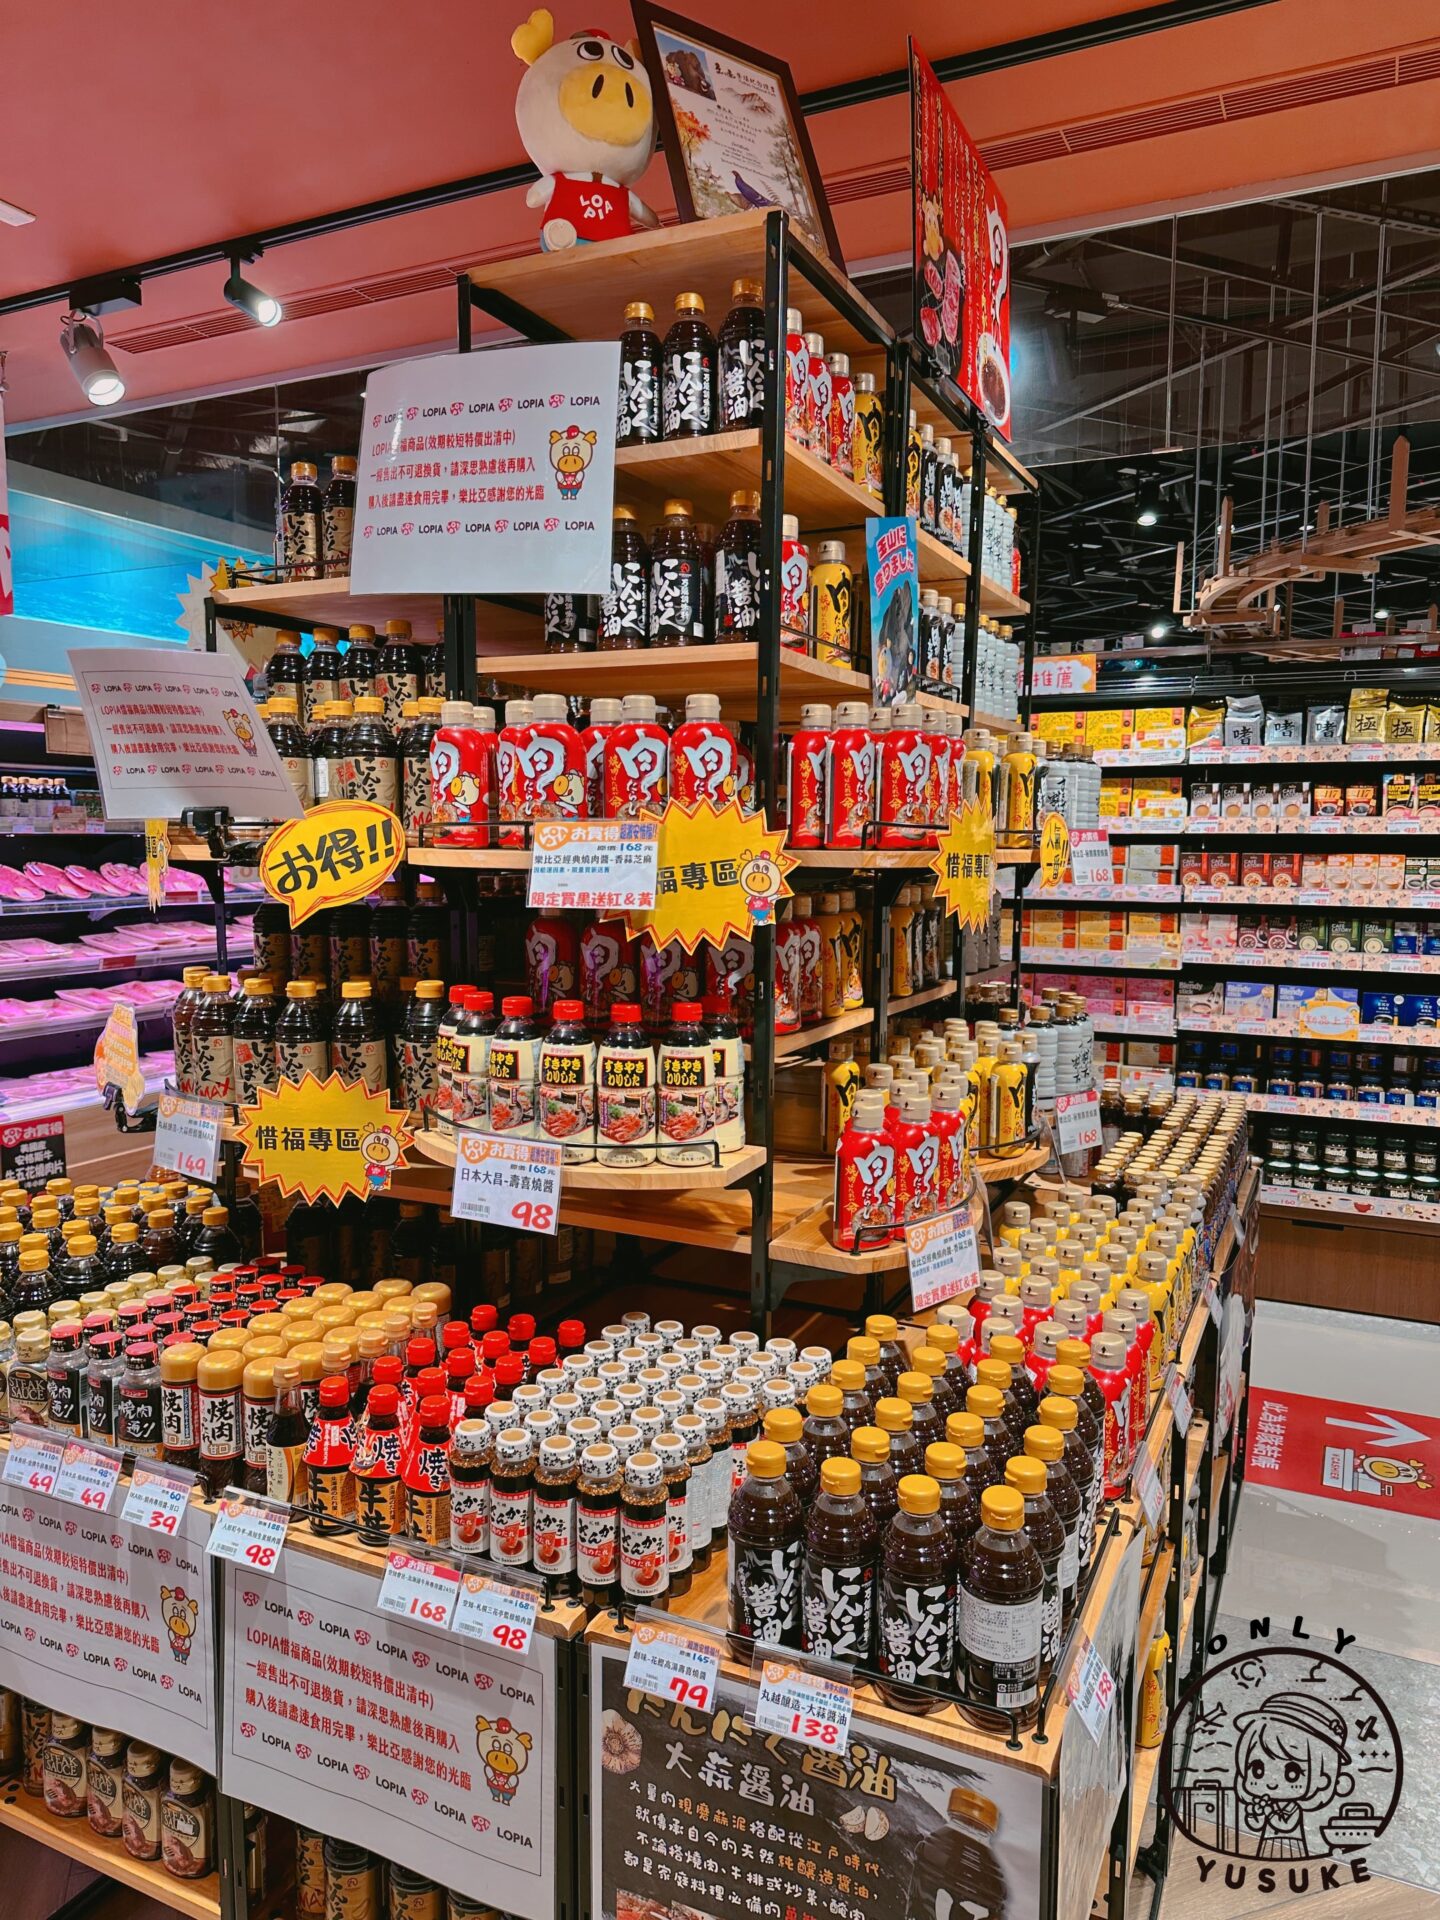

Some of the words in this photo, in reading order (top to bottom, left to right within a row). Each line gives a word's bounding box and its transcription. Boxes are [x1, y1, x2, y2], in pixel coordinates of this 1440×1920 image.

[422, 407, 447, 417] LOPIA
[469, 403, 495, 413] LOPIA
[517, 399, 544, 409] LOPIA
[570, 396, 600, 406] LOPIA
[376, 526, 398, 536] LOPIA
[418, 524, 443, 534] LOPIA
[465, 523, 491, 533] LOPIA
[513, 522, 540, 532] LOPIA
[565, 521, 595, 531] LOPIA
[268, 818, 395, 894] お得!!
[620, 843, 642, 851] 168
[1091, 869, 1108, 882] 168
[1179, 981, 1203, 991] Blendy
[544, 1055, 582, 1070] すきやき
[604, 1059, 646, 1074] すきやき
[664, 1057, 703, 1072] すきやき
[546, 1070, 577, 1084] わりした
[608, 1073, 641, 1087] わりした
[666, 1072, 699, 1086] わりした
[256, 1126, 360, 1152] 惜福專區
[1079, 1129, 1097, 1145] 168
[177, 1151, 206, 1176] 149
[528, 1164, 547, 1174] 168
[461, 1168, 554, 1193] 日本大昌-壽喜燒醬
[511, 1201, 554, 1229] 98
[9, 1378, 46, 1390] STEAK
[11, 1387, 45, 1400] SAUCE
[163, 1390, 183, 1434] 焼肉
[207, 1398, 235, 1442] 焼肉
[209, 1444, 230, 1455] 甘口
[374, 1433, 401, 1474] 焼き
[419, 1447, 448, 1490] 焼き
[29, 1472, 54, 1494] 49
[80, 1488, 106, 1511] 49
[169, 1491, 181, 1502] 60
[148, 1511, 178, 1534] 39
[0, 1503, 19, 1519] OPIA
[39, 1515, 62, 1531] LOPIA
[81, 1528, 107, 1545] LOPIA
[128, 1543, 154, 1560] LOPIA
[175, 1557, 199, 1576] LOPIA
[245, 1544, 276, 1566] 98
[409, 1598, 447, 1622] 168
[515, 1600, 529, 1610] 168
[821, 1567, 869, 1660] にんにく
[492, 1624, 527, 1650] 98
[905, 1585, 951, 1679] にんにく
[1, 1620, 22, 1637] LOPIA
[40, 1636, 63, 1653] LOPIA
[83, 1651, 110, 1667] LOPIA
[132, 1665, 157, 1684] LOPIA
[178, 1684, 203, 1704] LOPIA
[264, 1600, 294, 1619] LOPIA
[319, 1620, 350, 1640] LOPIA
[376, 1640, 408, 1662] LOPIA
[436, 1662, 469, 1684] LOPIA
[500, 1683, 535, 1706] LOPIA
[692, 1653, 710, 1664] 145
[669, 1677, 708, 1709] 79
[828, 1692, 845, 1702] 168
[760, 1688, 848, 1727] 丸越釀造-大蒜醬油
[790, 1714, 839, 1745] 138
[262, 1731, 292, 1753] LOPIA
[317, 1753, 349, 1775] LOPIA
[375, 1775, 407, 1798] LOPIA
[434, 1801, 467, 1825] LOPIA
[497, 1826, 533, 1849] LOPIA
[629, 1780, 881, 1878] 大量的現磨蒜泥搭配從江戶時代
